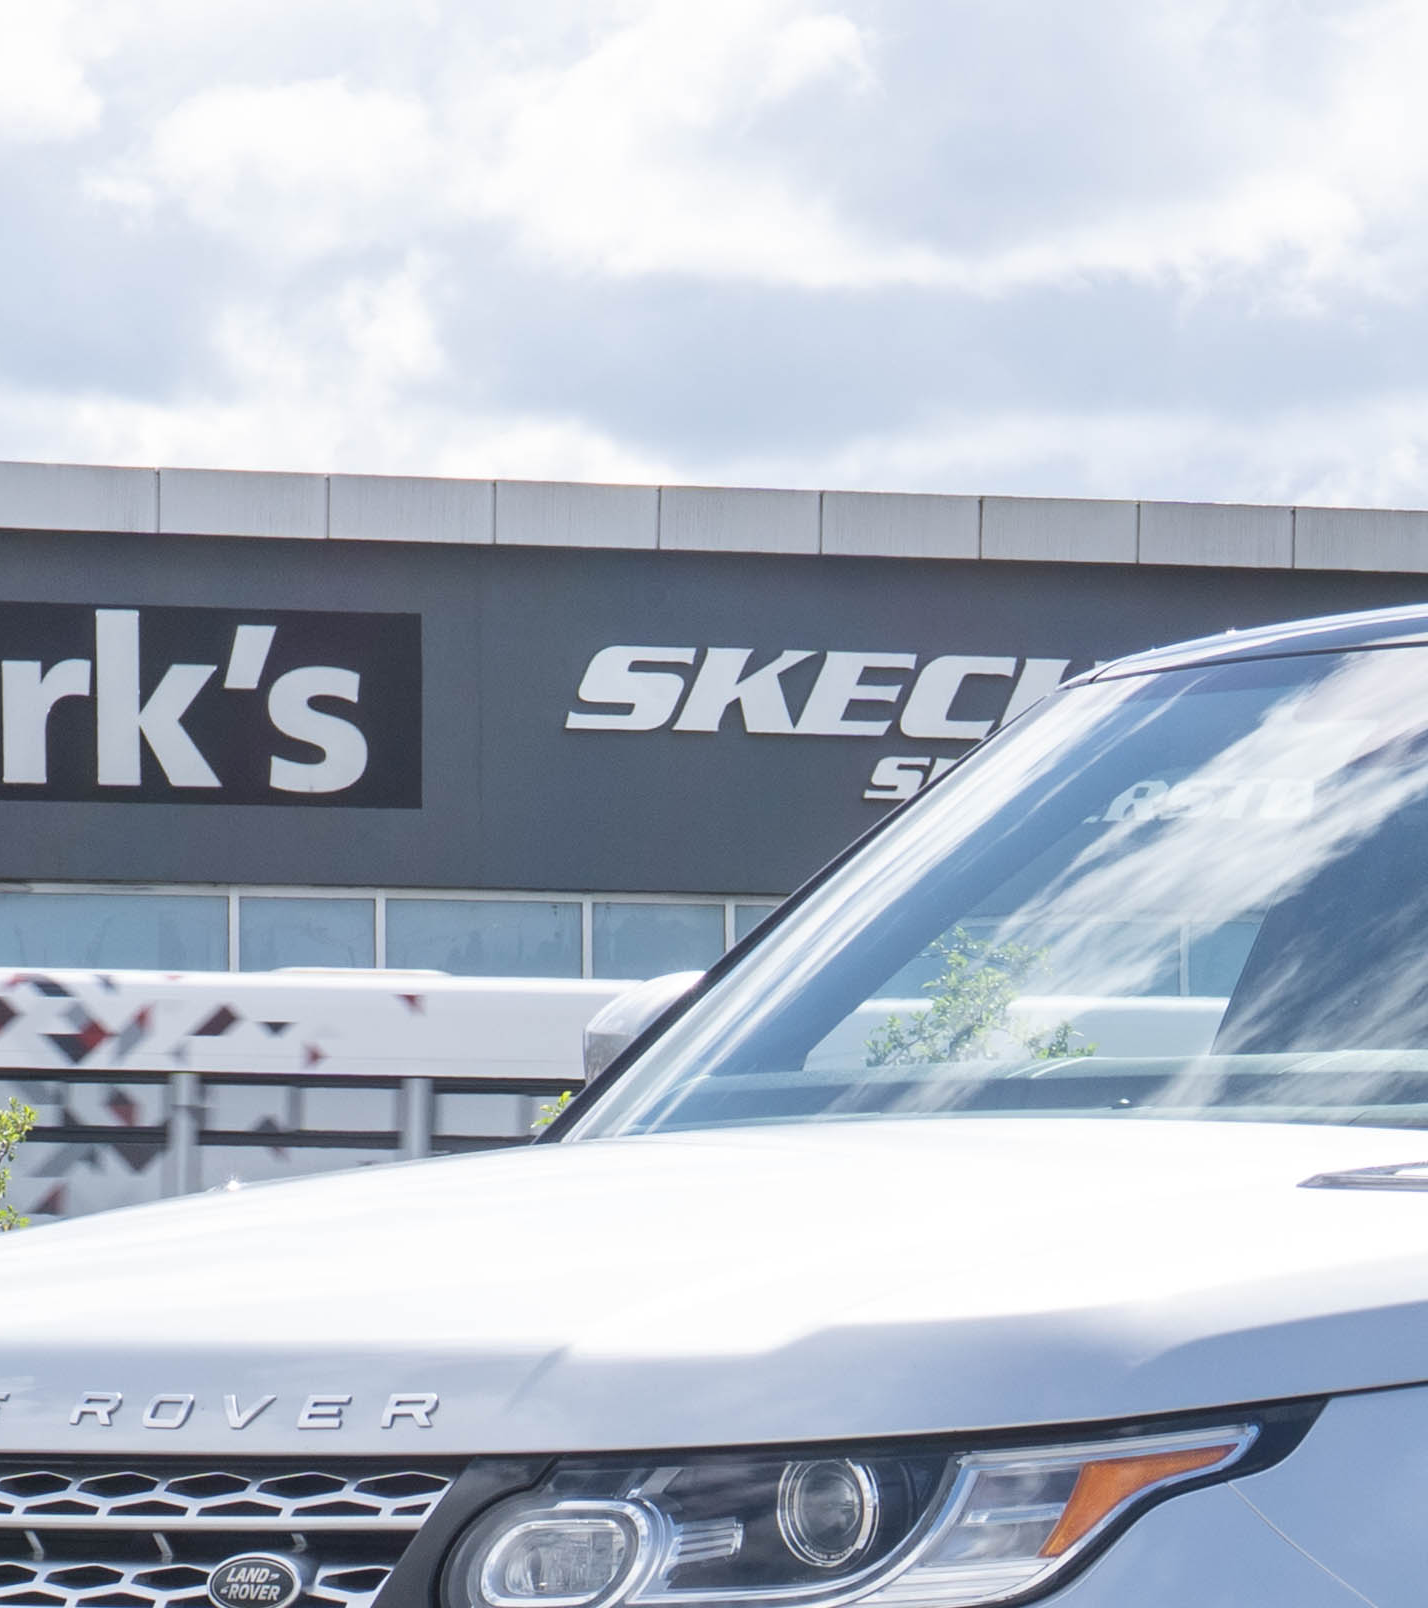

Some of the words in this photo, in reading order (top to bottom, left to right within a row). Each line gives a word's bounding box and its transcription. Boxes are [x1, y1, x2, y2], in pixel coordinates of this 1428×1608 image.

[68, 1390, 440, 1430] ROVER
[226, 1567, 270, 1583] LAND
[227, 1584, 281, 1600] ROVER
